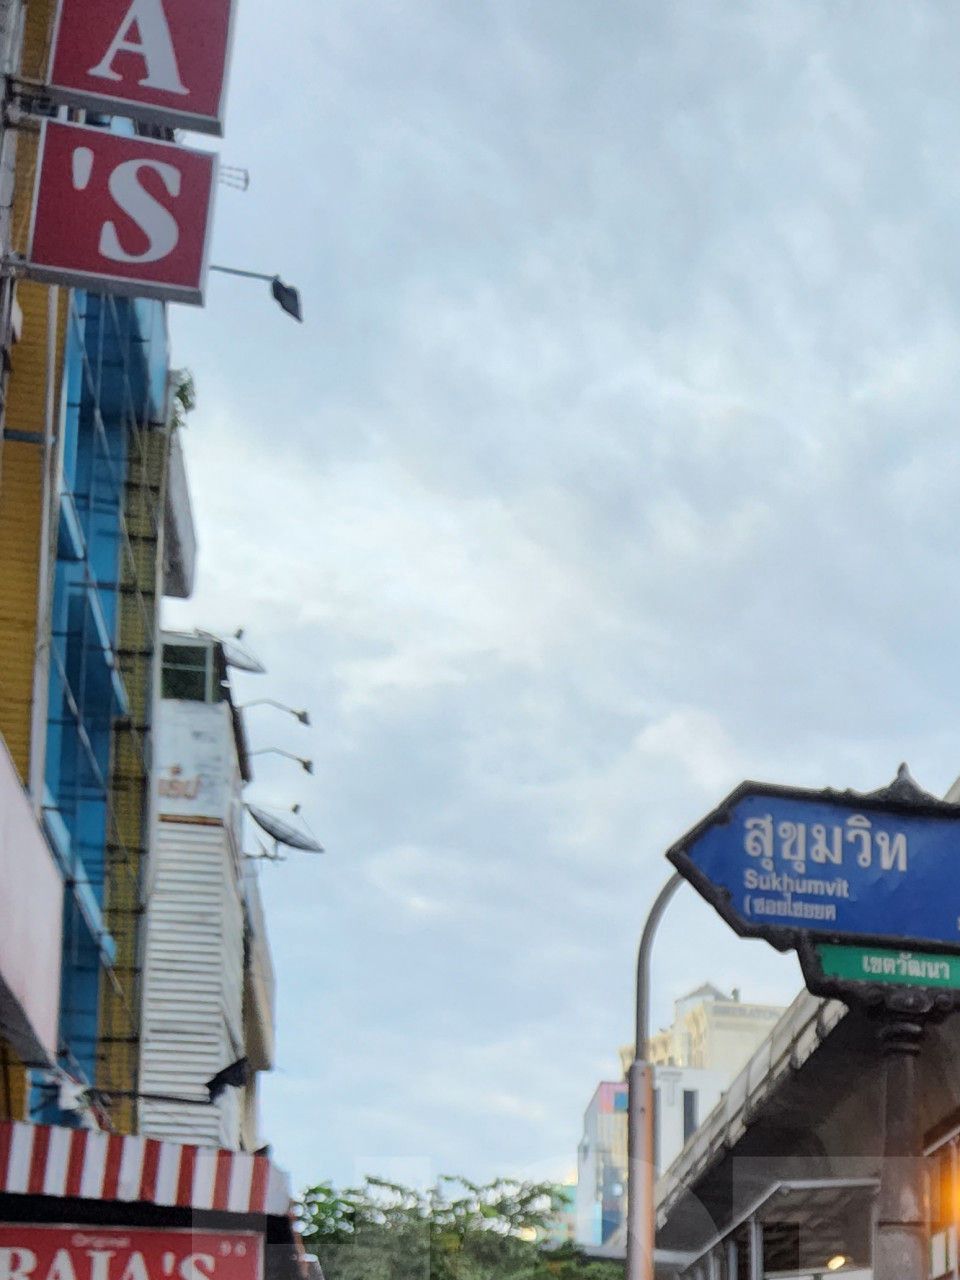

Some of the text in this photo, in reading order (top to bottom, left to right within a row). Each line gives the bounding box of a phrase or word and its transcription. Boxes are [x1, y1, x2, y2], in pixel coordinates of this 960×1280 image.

[86, 0, 190, 95] A
[71, 146, 182, 263] 'S
[743, 813, 908, 874] สุขุมวิท
[743, 868, 850, 898] Sukhumvit
